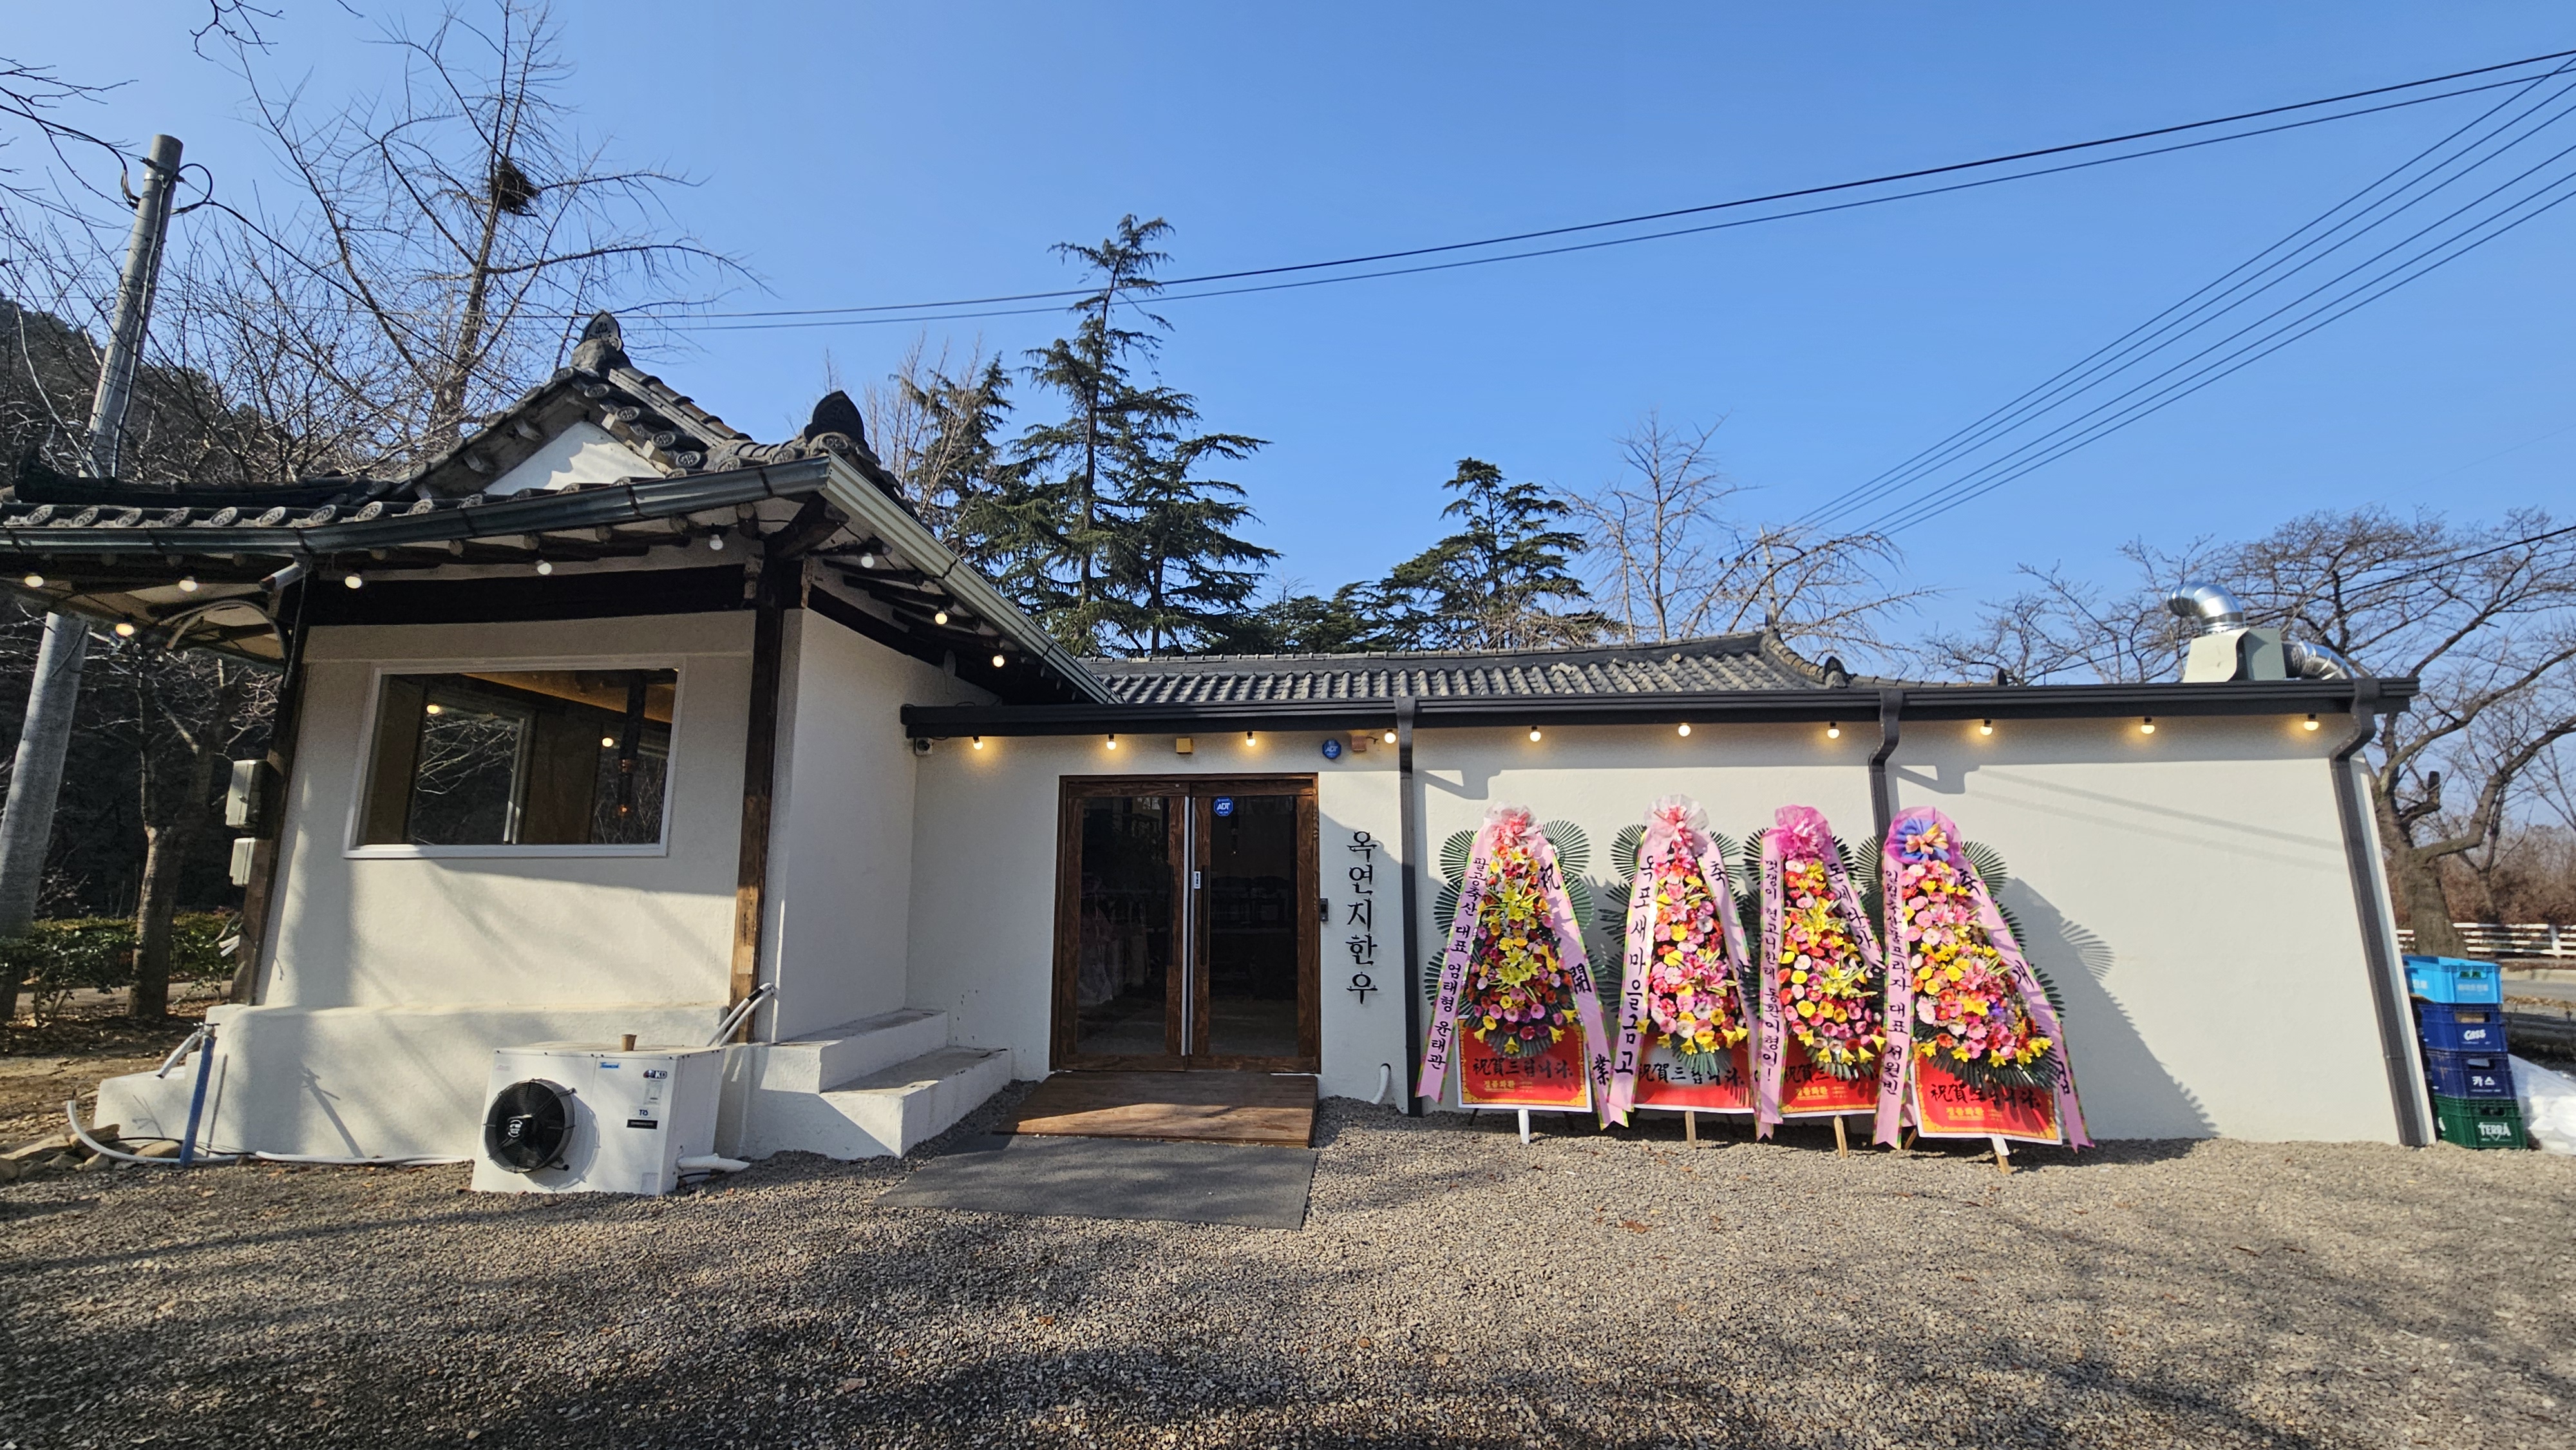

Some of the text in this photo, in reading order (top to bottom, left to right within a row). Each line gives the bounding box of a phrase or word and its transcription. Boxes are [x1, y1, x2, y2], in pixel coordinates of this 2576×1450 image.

[1217, 802, 1231, 811] ADT
[1709, 860, 1727, 888] 축
[1765, 859, 1778, 900] 멋쟁이
[1345, 831, 1378, 1004] 옥연지한우
[1827, 863, 1874, 949] 돈세다가
[1958, 868, 1982, 896] 축
[2012, 960, 2035, 990] 개
[1428, 857, 1490, 1070] 팔공축산 대표 엄태형 윤태관
[1539, 862, 1611, 1086] 祝 開 業
[1614, 855, 1654, 1076] 옥포새마을금고
[1888, 1001, 1908, 1035] 대표
[2472, 1075, 2496, 1087] 카스
[2477, 1122, 2512, 1136] TERRA
